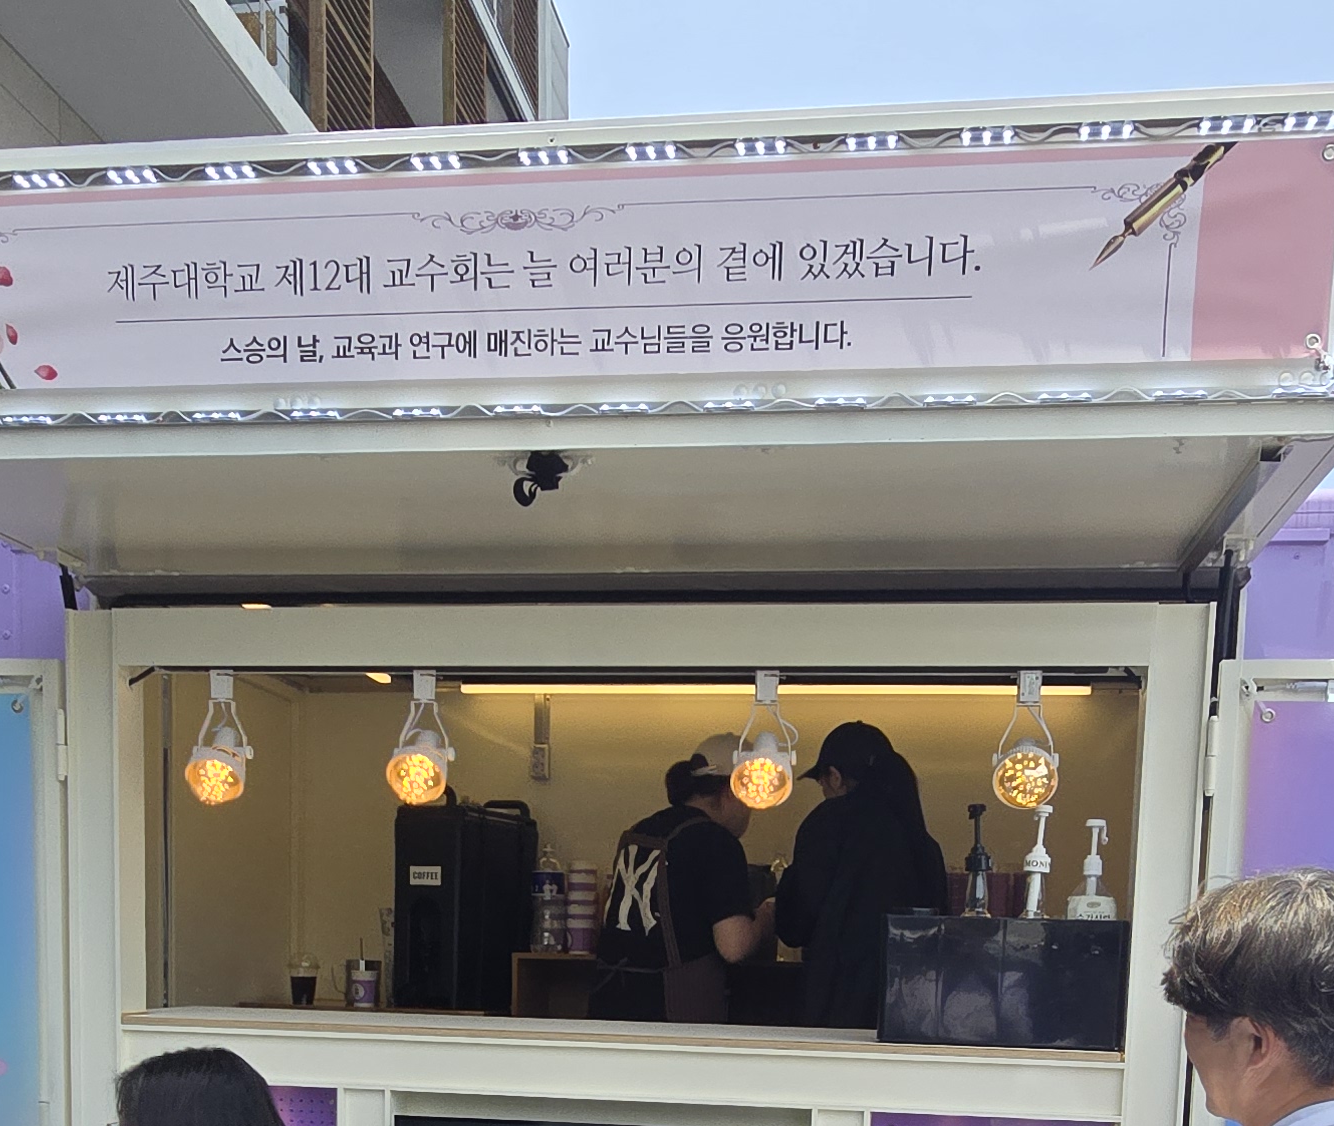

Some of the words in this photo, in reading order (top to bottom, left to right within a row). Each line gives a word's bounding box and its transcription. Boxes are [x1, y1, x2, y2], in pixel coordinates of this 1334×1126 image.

[108, 261, 264, 301] 제주대학교
[276, 256, 370, 296] 제12대
[383, 252, 514, 292] 교수회는
[523, 251, 557, 288] 늘
[570, 244, 701, 287] 여러분의
[719, 241, 782, 281] 곁에
[800, 234, 980, 280] 있겠습니다.
[221, 336, 287, 364] 스승의
[298, 335, 323, 363] 날,
[332, 333, 401, 361] 교육과
[410, 330, 476, 359] 연구에
[487, 328, 581, 357] 매진하는
[590, 324, 713, 354] 교수님들을
[722, 321, 851, 352] 응원합니다.
[412, 871, 439, 881] COFFEE
